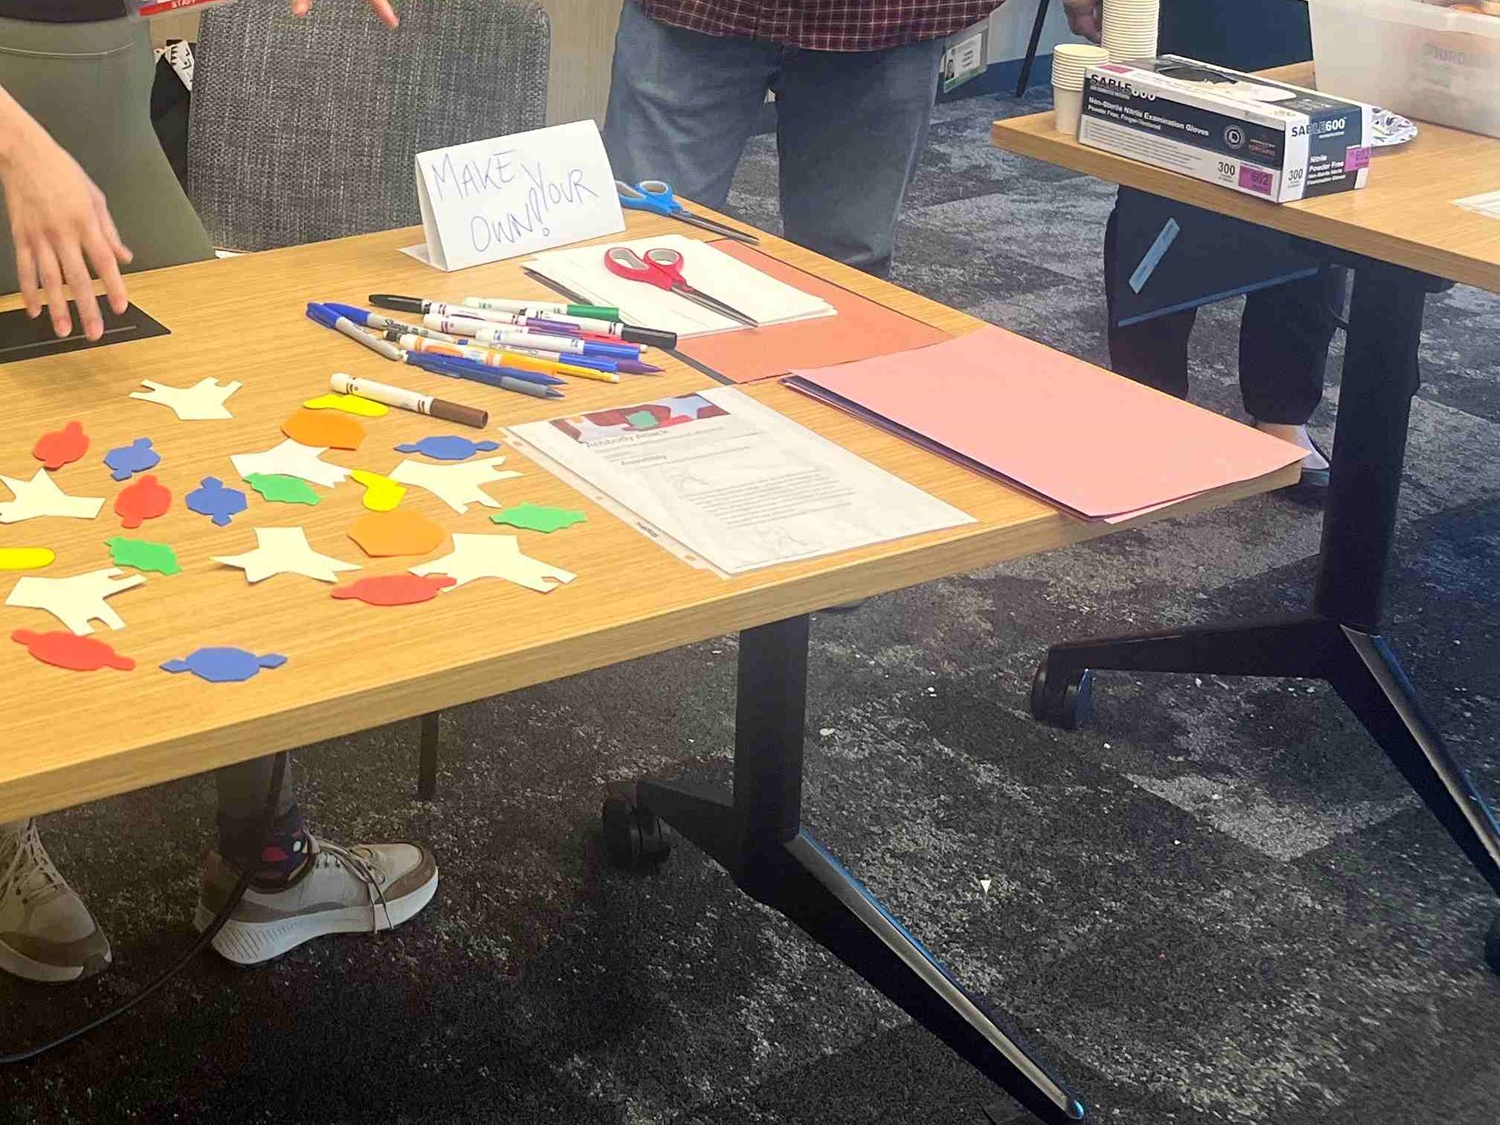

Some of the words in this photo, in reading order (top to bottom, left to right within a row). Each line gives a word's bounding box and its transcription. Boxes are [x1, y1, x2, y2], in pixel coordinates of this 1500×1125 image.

[1143, 112, 1185, 130] Examination
[1185, 124, 1210, 136] Gloves
[1291, 118, 1346, 137] SABLE600
[1218, 161, 1236, 176] 300
[1288, 168, 1304, 181] 300
[431, 149, 517, 202] MAKE
[521, 161, 599, 211] YOUR
[470, 187, 550, 252] OWN!
